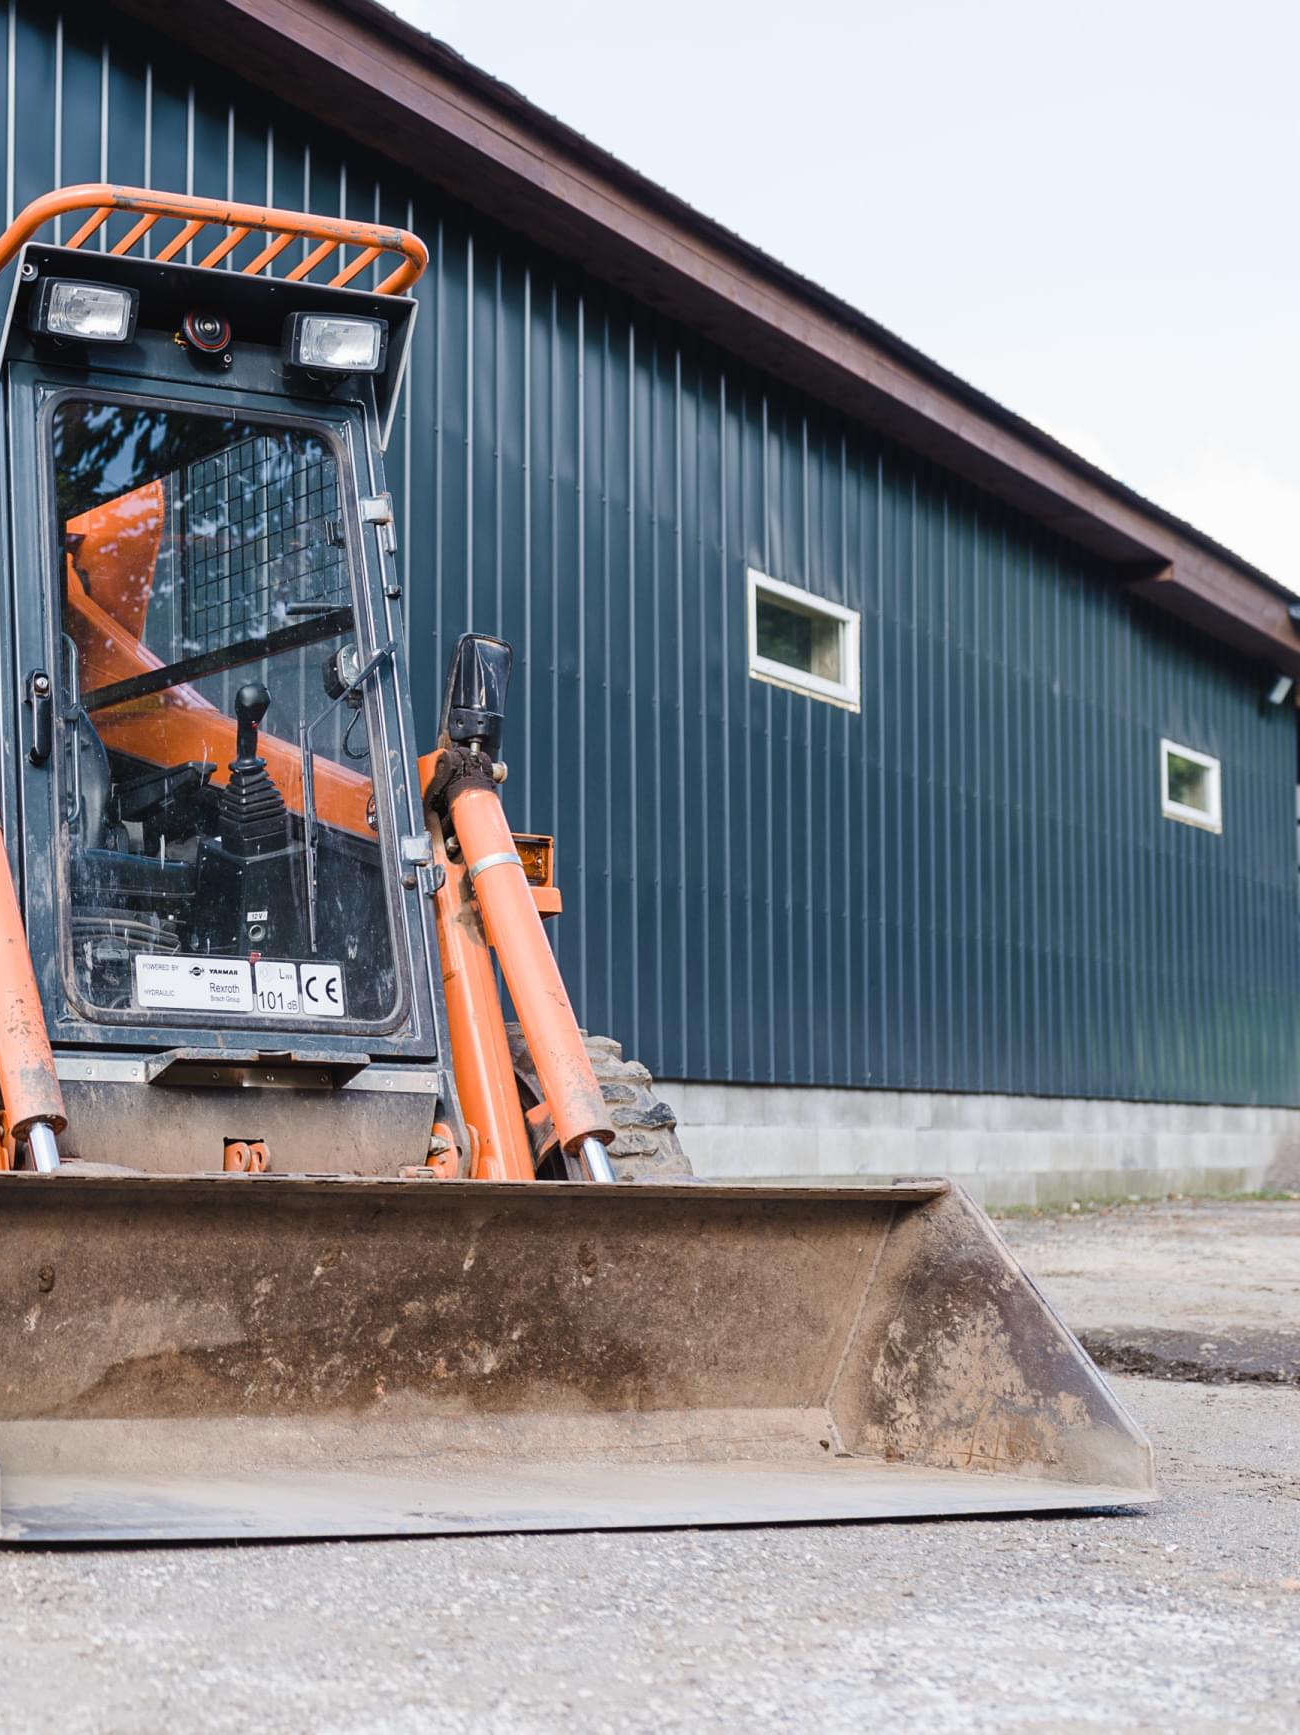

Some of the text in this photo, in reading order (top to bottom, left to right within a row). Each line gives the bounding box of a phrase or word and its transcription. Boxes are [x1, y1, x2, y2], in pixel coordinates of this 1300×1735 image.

[209, 982, 240, 994] Rexroth
[258, 991, 298, 1010] 101 dB
